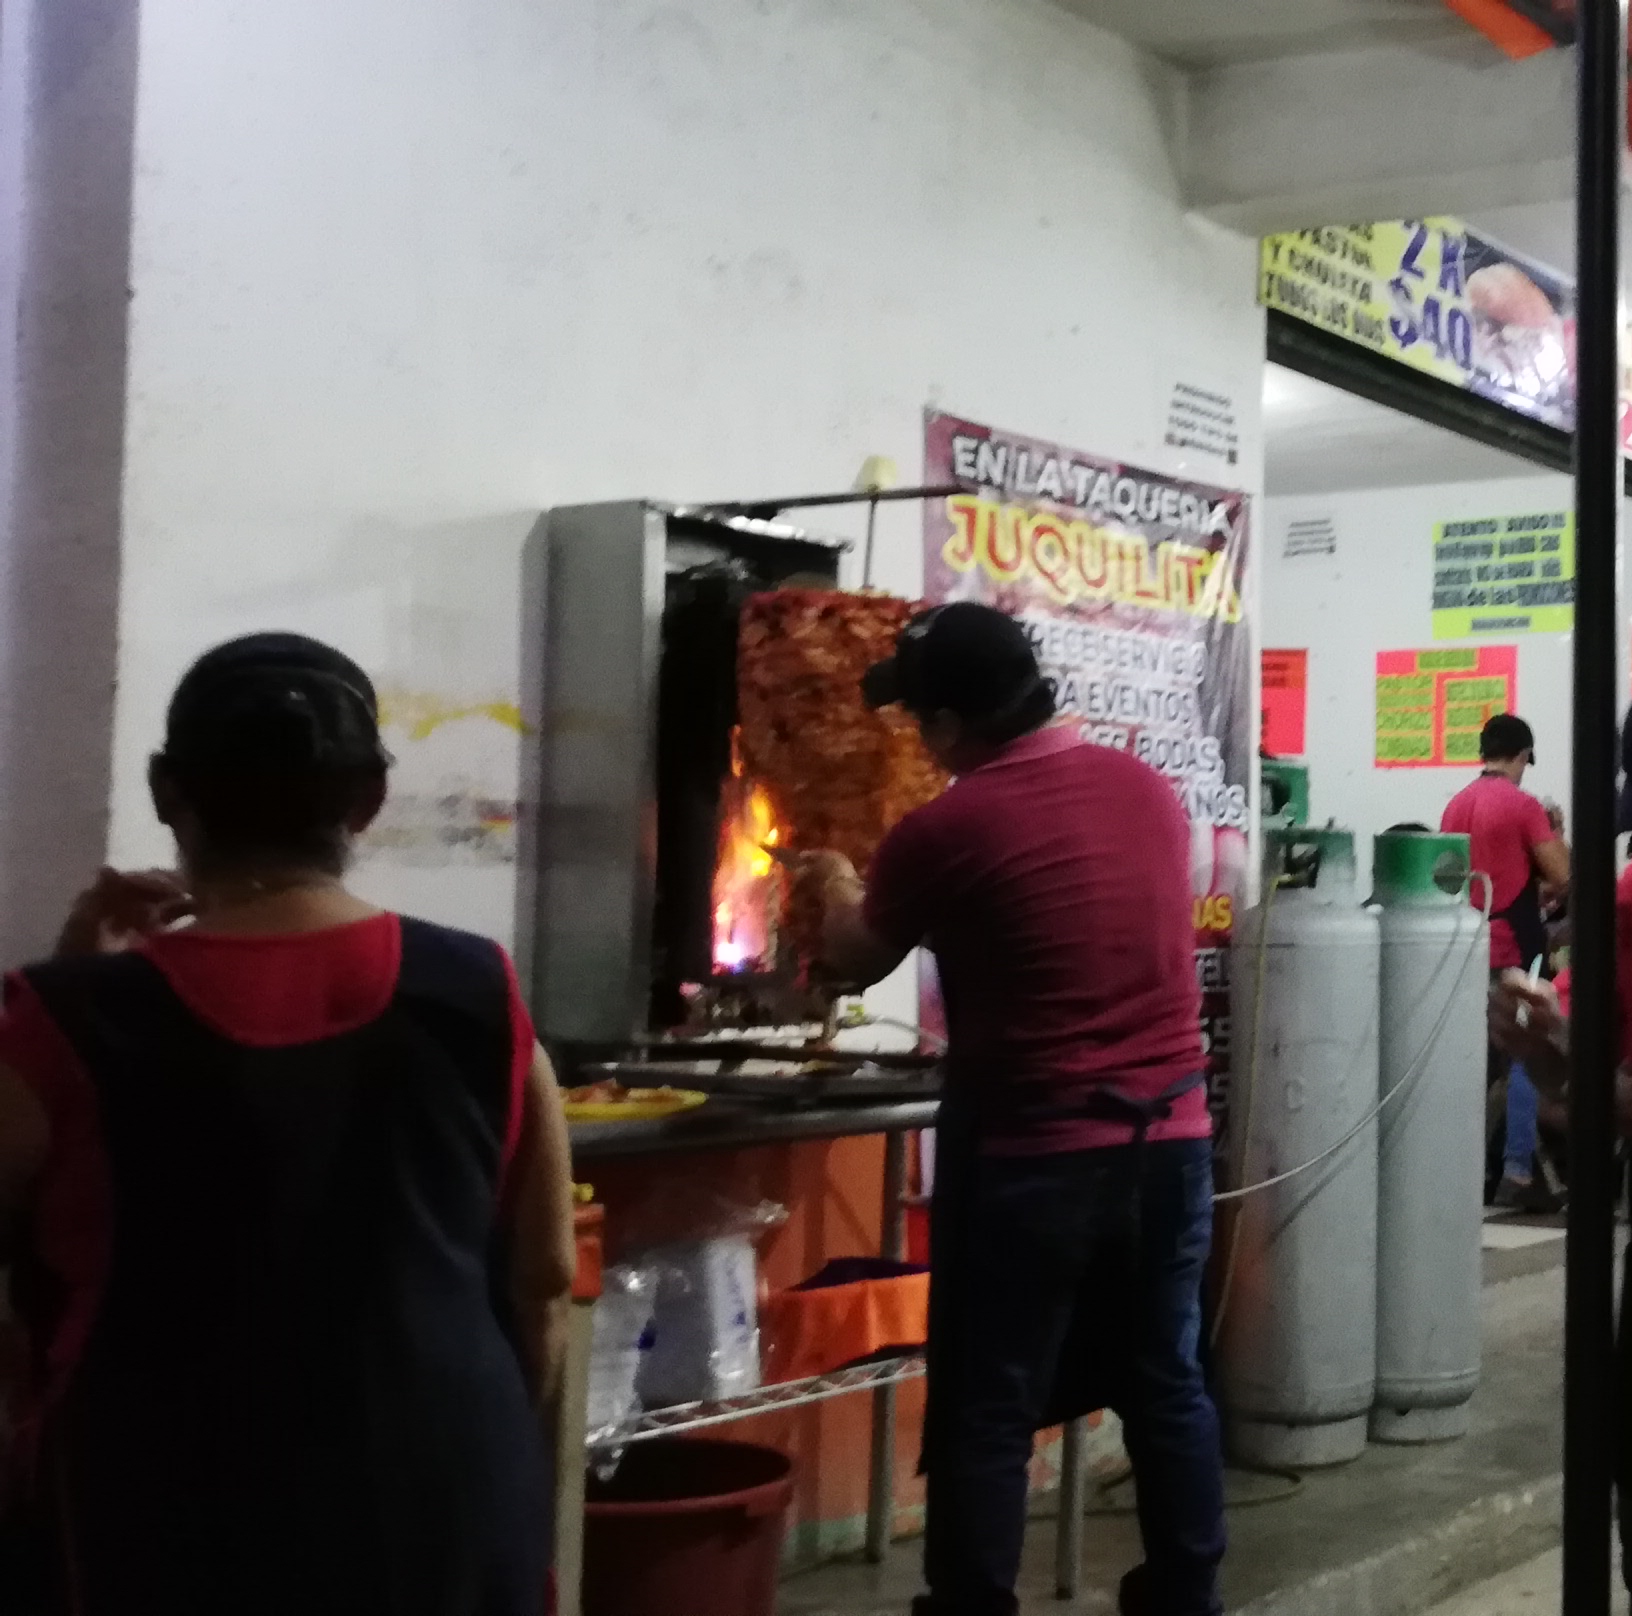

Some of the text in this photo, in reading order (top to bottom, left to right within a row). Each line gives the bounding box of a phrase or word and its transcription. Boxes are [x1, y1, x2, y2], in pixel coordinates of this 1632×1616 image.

[952, 436, 1232, 535] EN LA TAQUERIA
[943, 495, 1241, 624] JUQUILITA
[1100, 630, 1207, 684] SERVICIO
[1086, 677, 1198, 726] EVENTOS
